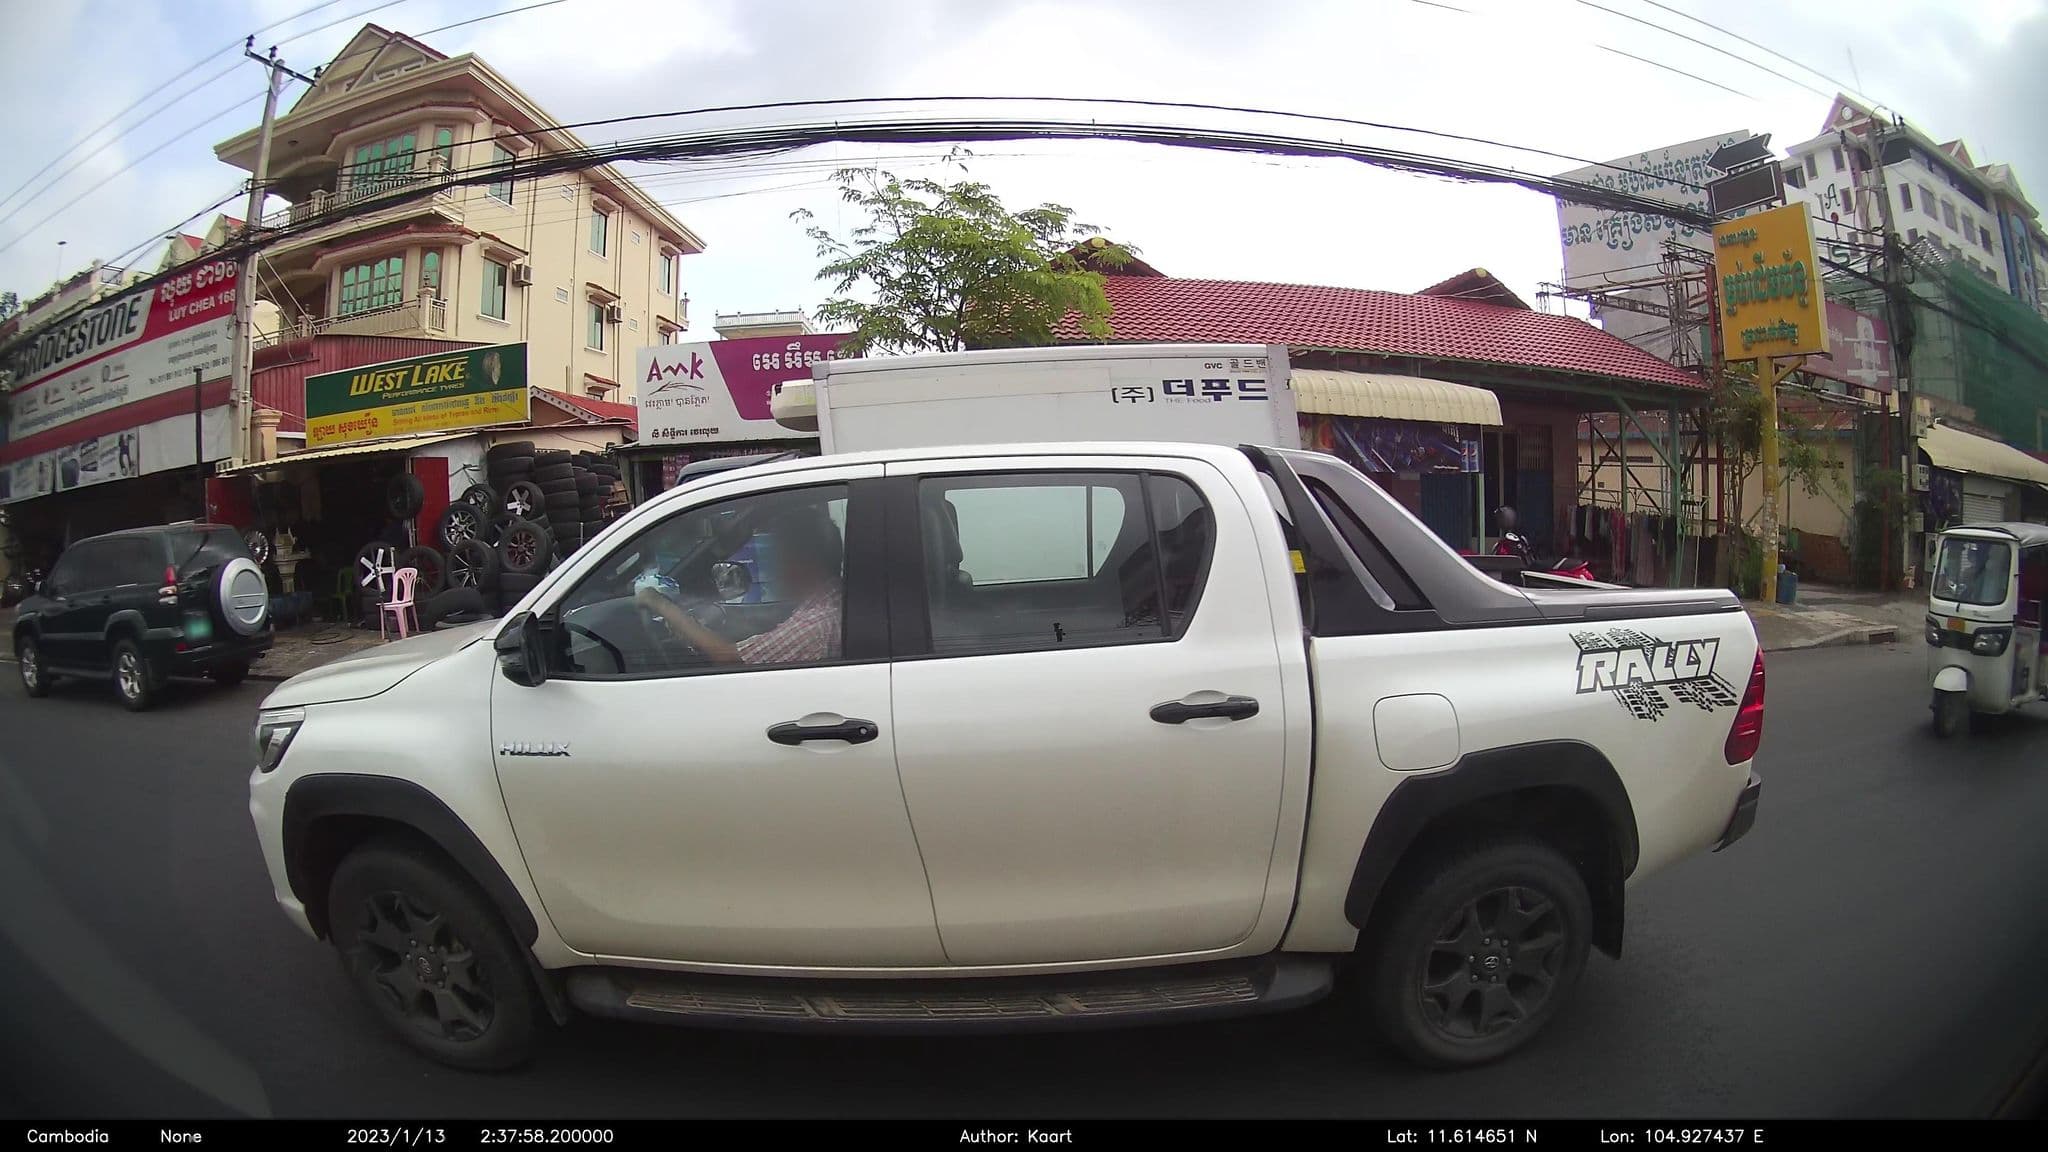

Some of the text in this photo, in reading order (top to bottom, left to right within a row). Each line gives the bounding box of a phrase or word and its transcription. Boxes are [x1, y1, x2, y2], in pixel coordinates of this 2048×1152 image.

[168, 304, 188, 322] LUY
[189, 294, 216, 315] CHEA
[350, 361, 468, 396] WEST LAKE
[1576, 637, 1721, 694] RALLY
